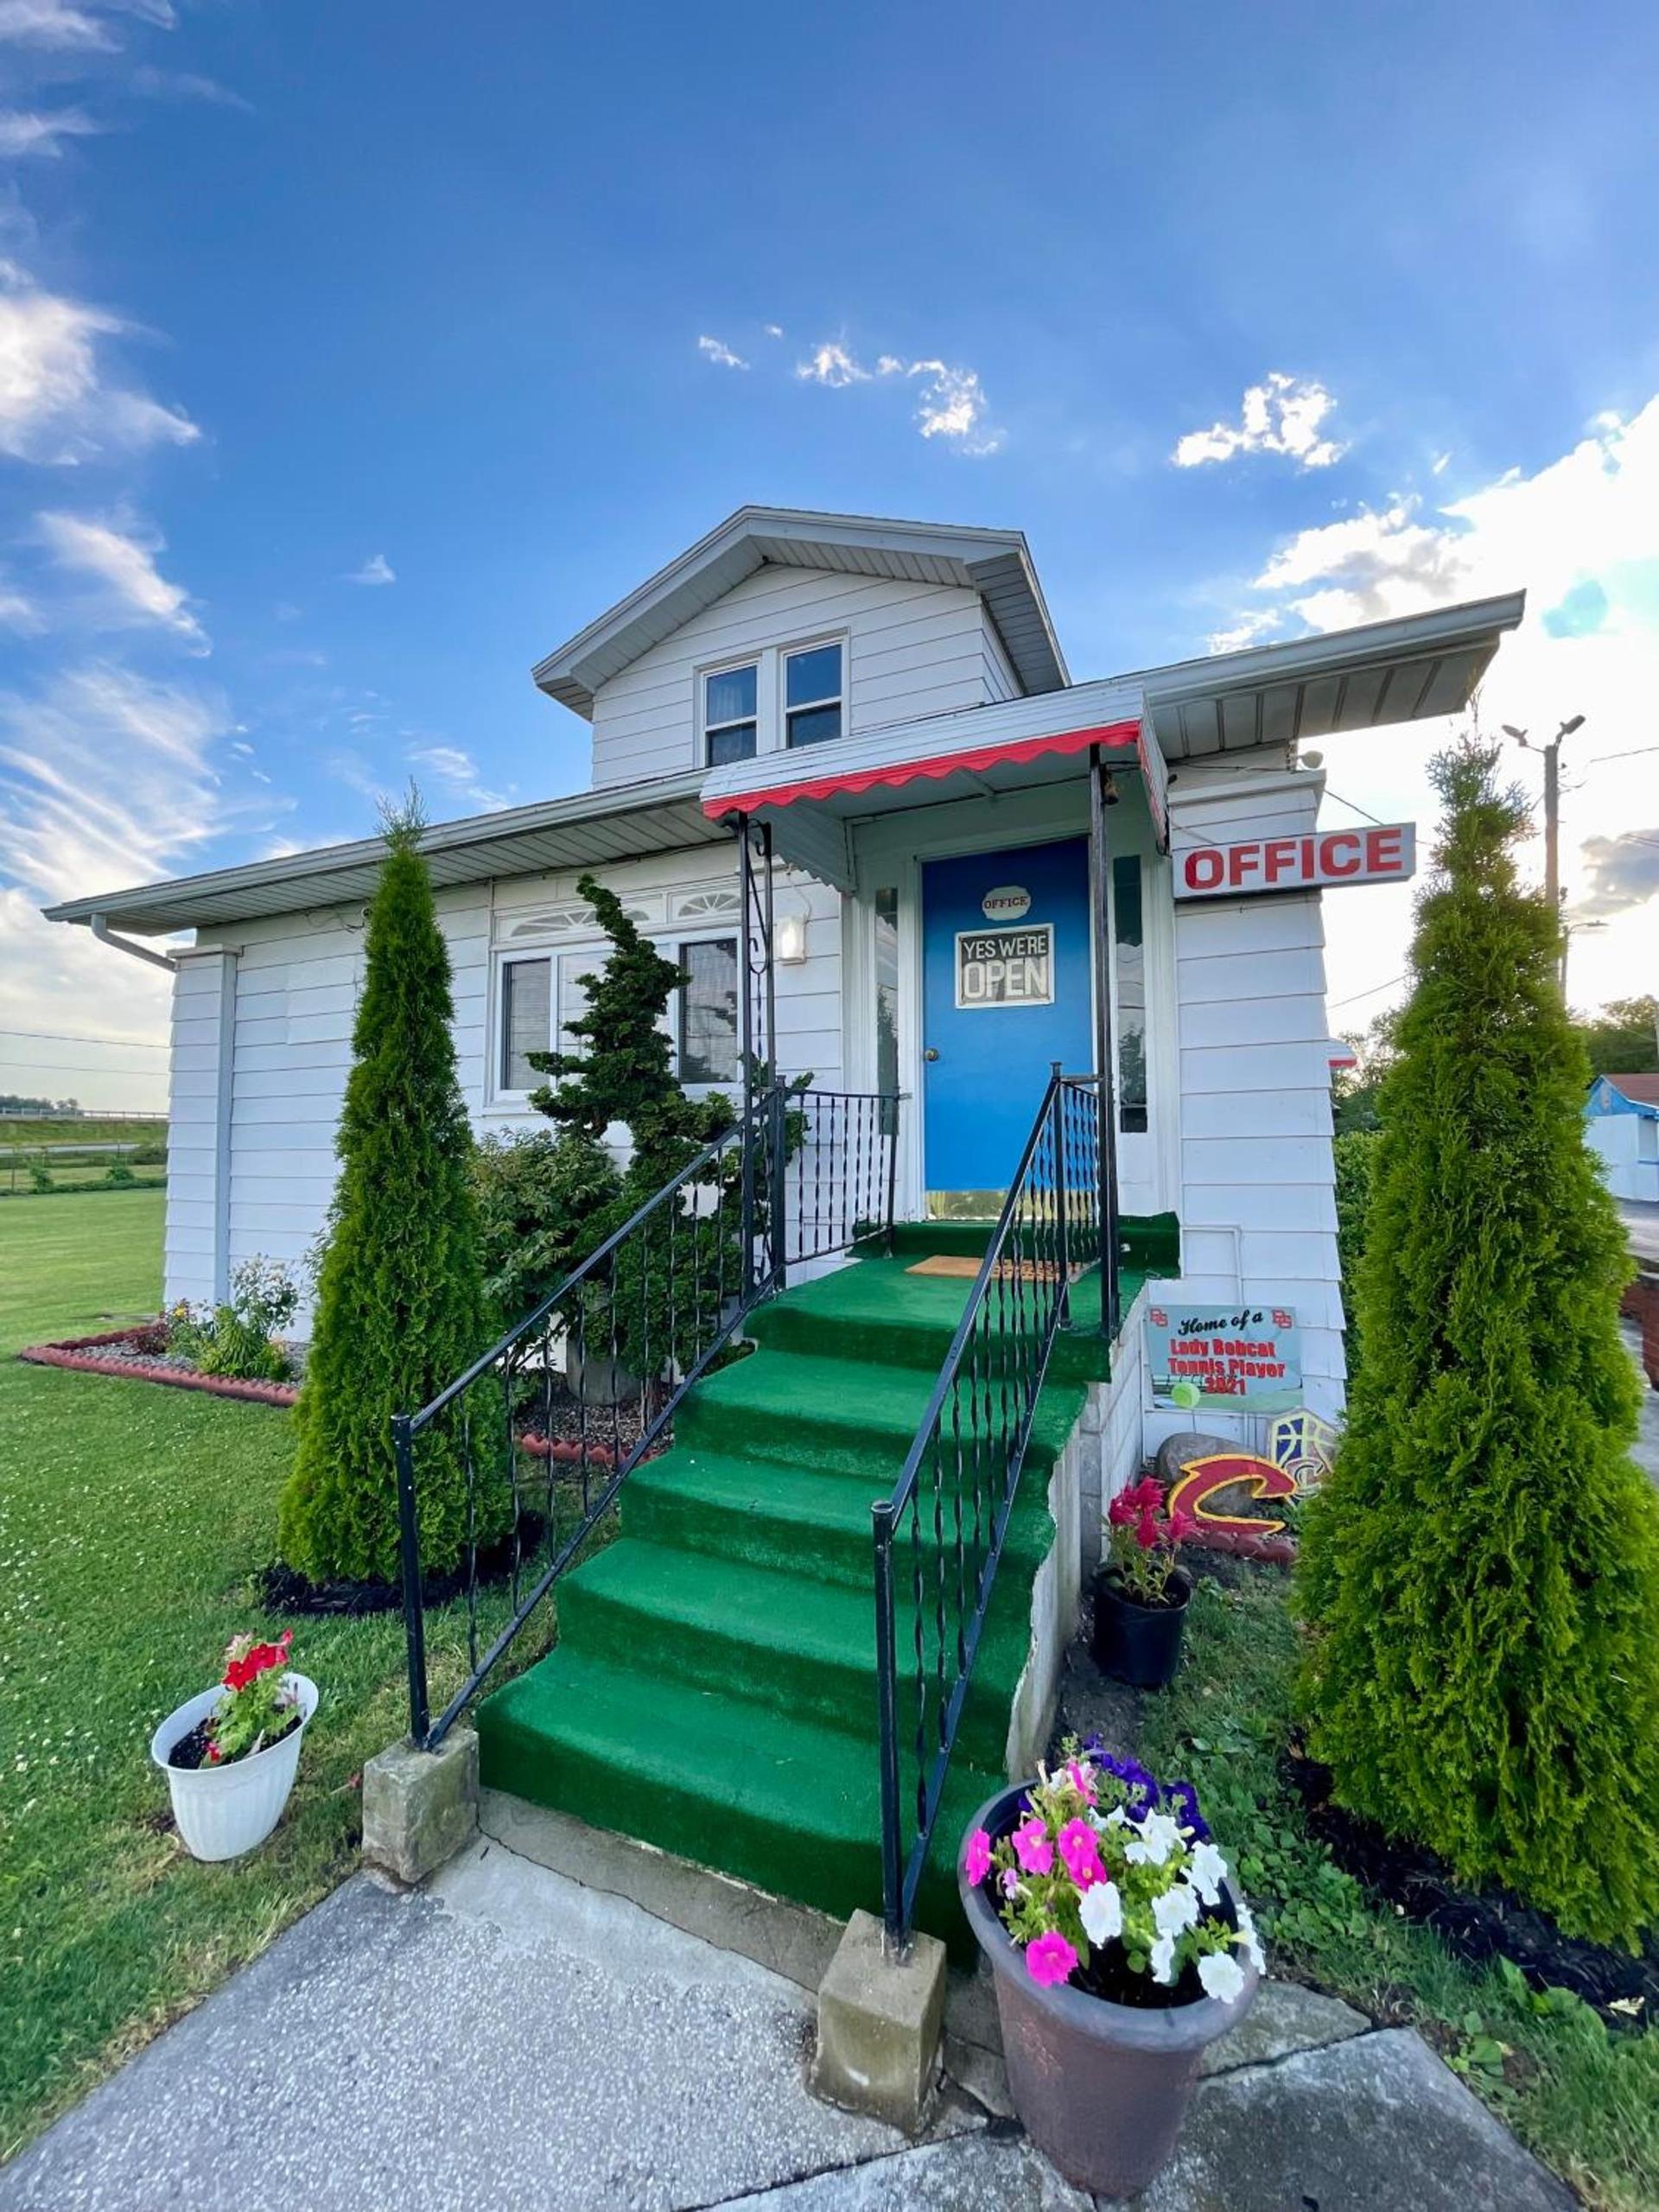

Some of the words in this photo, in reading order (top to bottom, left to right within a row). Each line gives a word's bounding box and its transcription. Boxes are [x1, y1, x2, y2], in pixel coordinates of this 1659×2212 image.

[1185, 828, 1402, 890] OFFICE
[984, 895, 1028, 909] OFFICE
[963, 939, 996, 960] YES
[963, 956, 1047, 999] OPEN
[1178, 1317, 1228, 1337] Home
[1230, 1308, 1251, 1331] of
[1251, 1310, 1264, 1323] a
[1169, 1338, 1210, 1357] Lady
[1212, 1338, 1277, 1358] Bobcat
[1167, 1357, 1225, 1377] Tennis
[1227, 1359, 1286, 1380] Player
[1205, 1375, 1247, 1395] 2021
